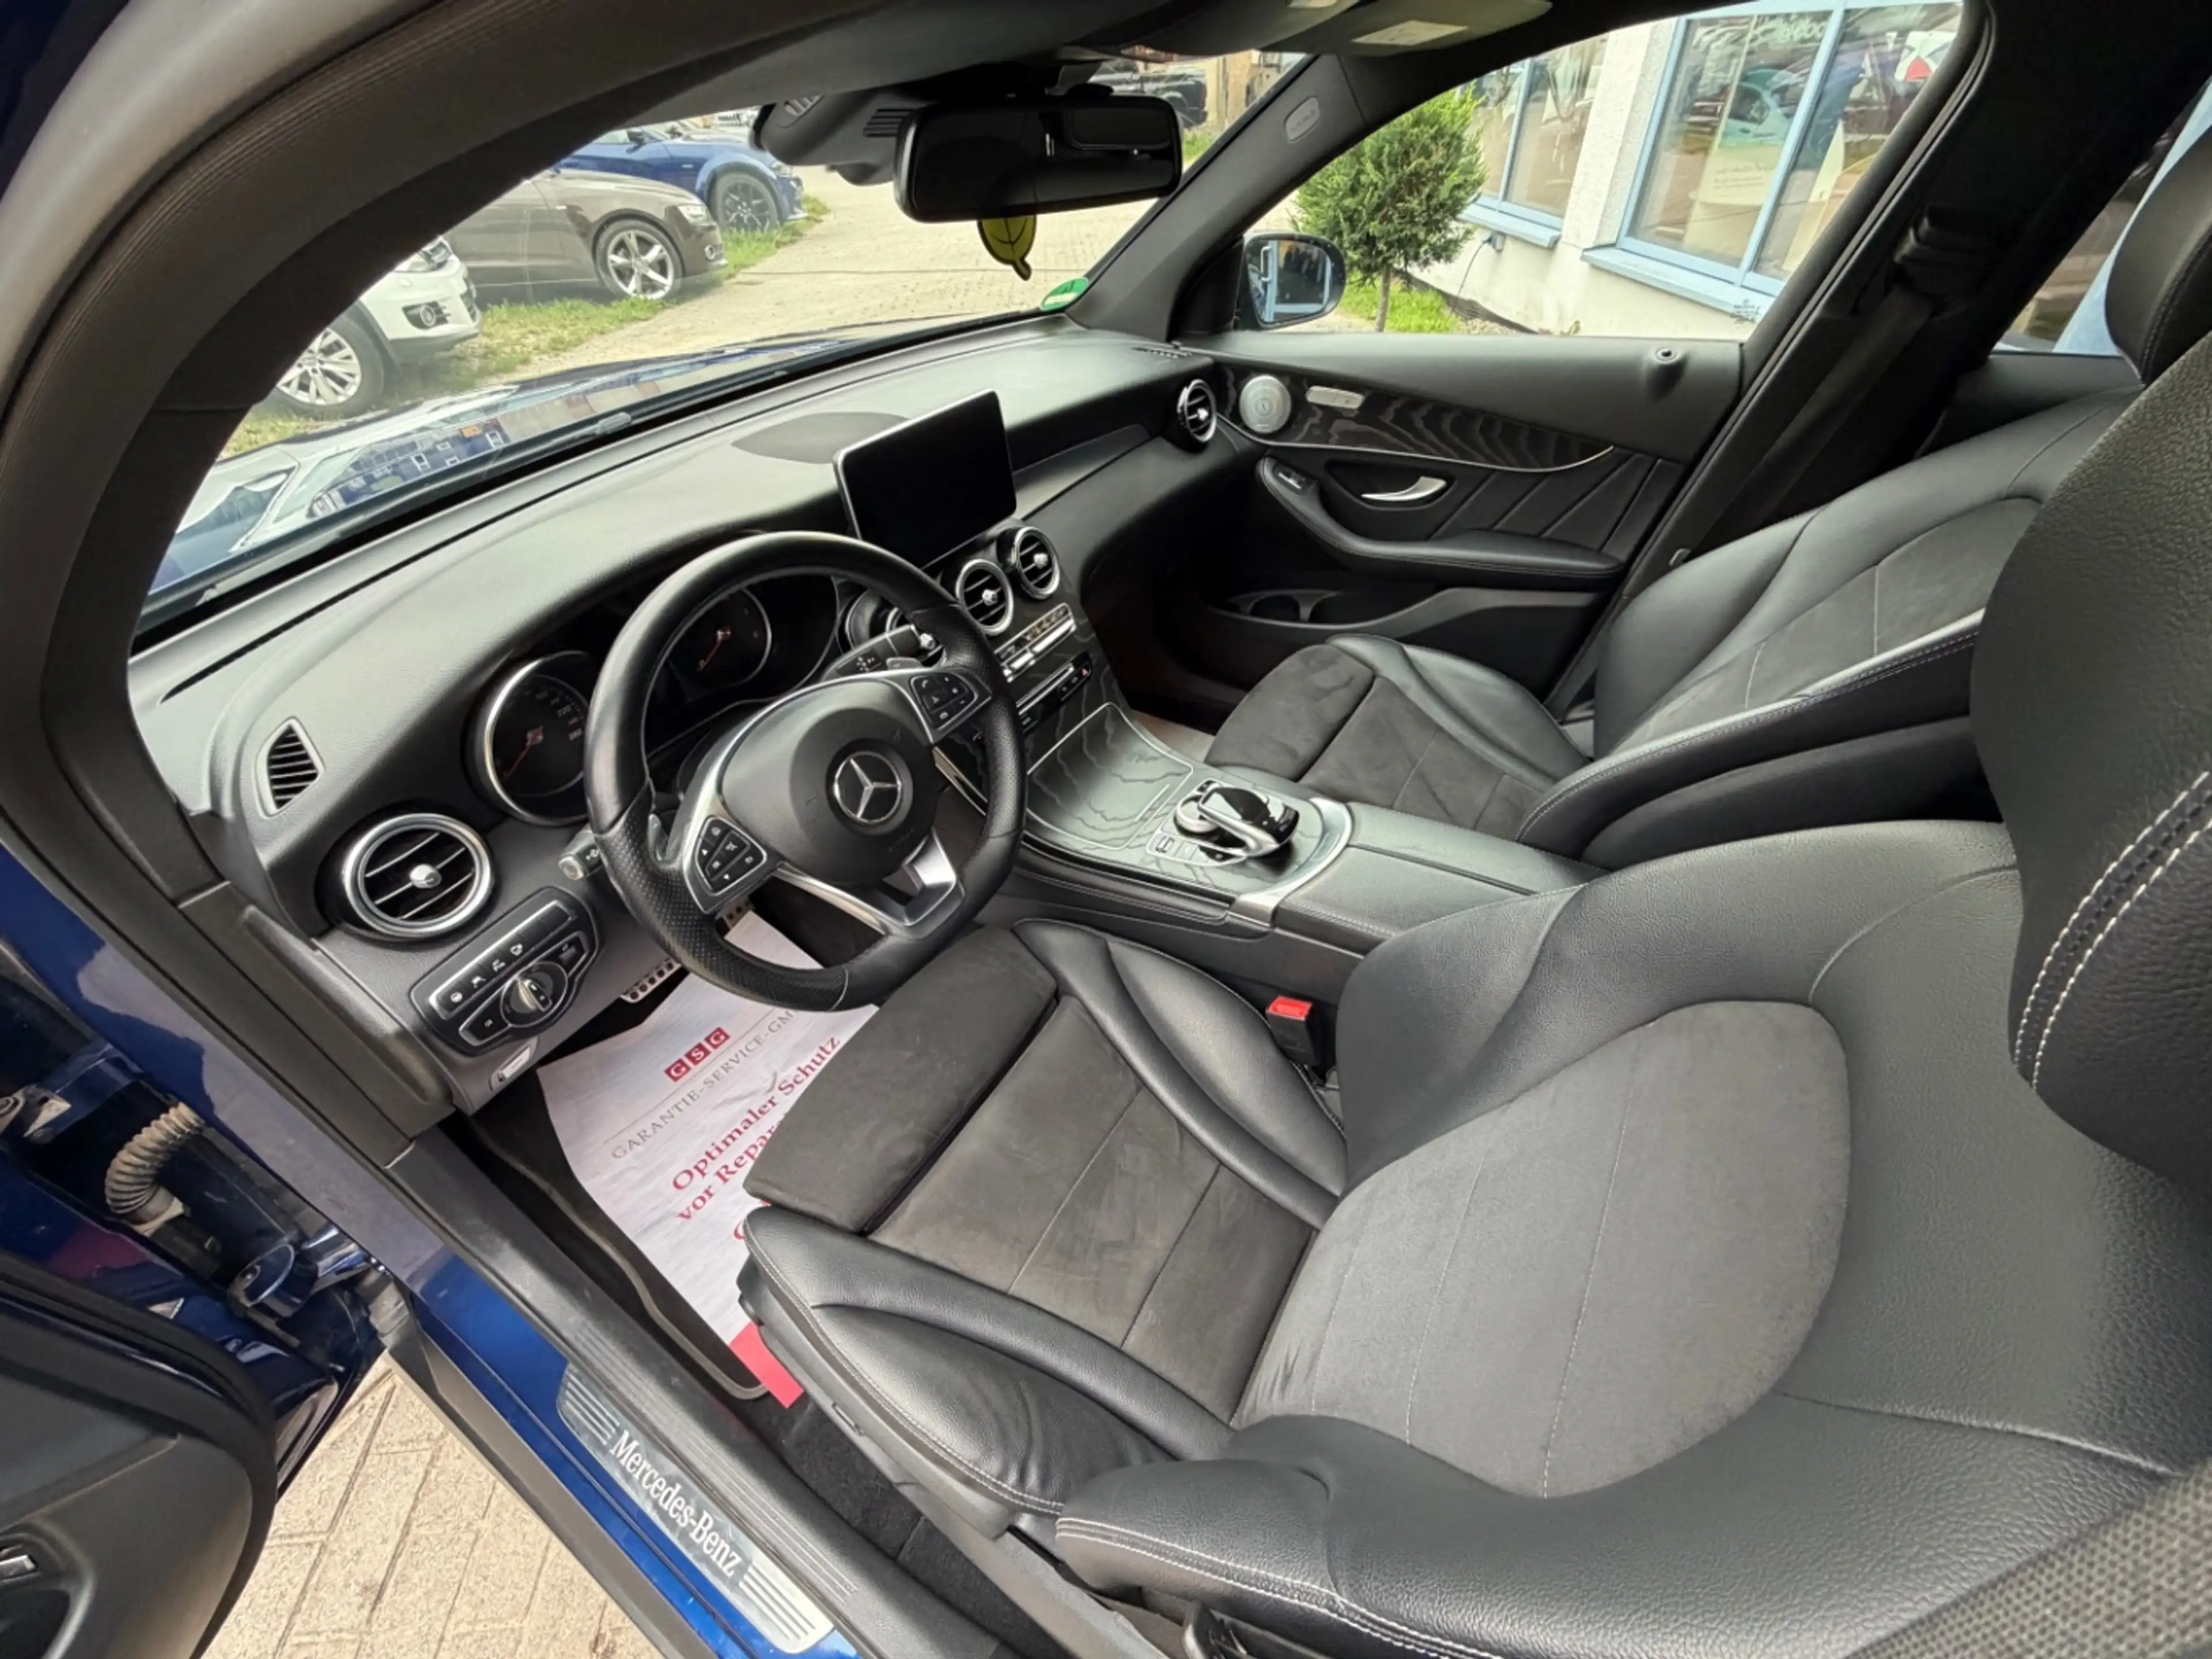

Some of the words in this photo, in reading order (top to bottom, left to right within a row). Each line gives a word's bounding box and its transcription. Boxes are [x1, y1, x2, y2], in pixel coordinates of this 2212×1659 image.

[611, 1009, 795, 1159] GARANTIE-SERVICE-GM
[672, 1095, 779, 1191] Optimaler
[777, 1037, 841, 1097] Schutz
[677, 1185, 716, 1221] vor
[714, 1124, 778, 1185] Repar
[609, 1430, 743, 1578] Mercedes-Benz
